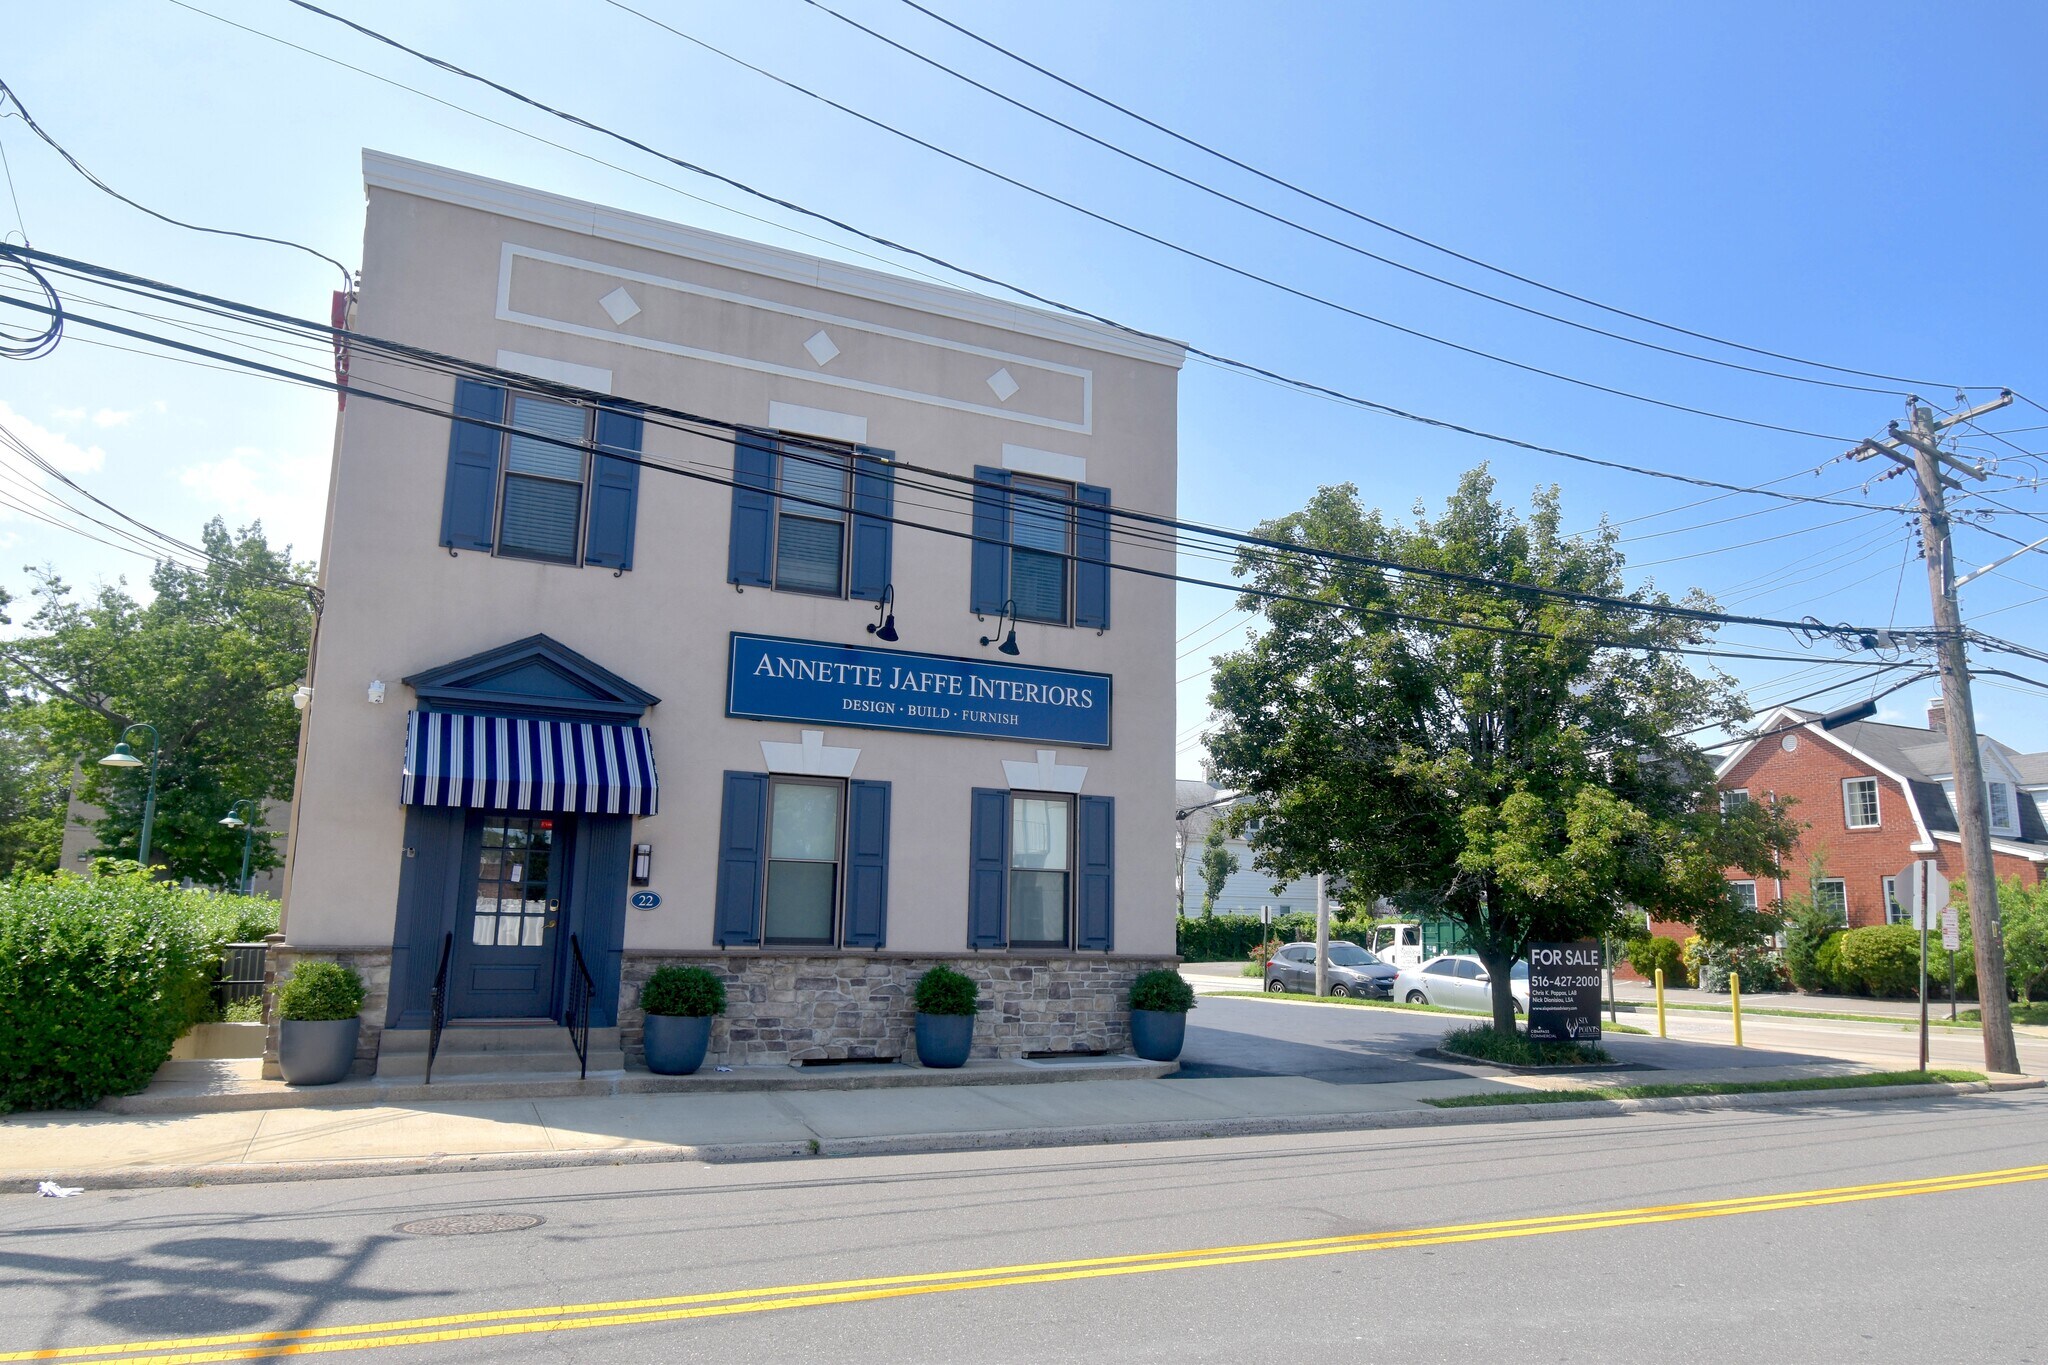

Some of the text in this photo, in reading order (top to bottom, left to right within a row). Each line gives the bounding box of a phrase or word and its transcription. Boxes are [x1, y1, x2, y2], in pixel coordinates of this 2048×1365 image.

[753, 653, 1093, 709] ANNETTE JAFFE INTERIORS
[842, 698, 1019, 725] DESIGN BUILD FURNISH
[638, 895, 653, 906] 22
[1531, 949, 1599, 966] FOR SALE
[1531, 976, 1600, 987] 516-427-2000
